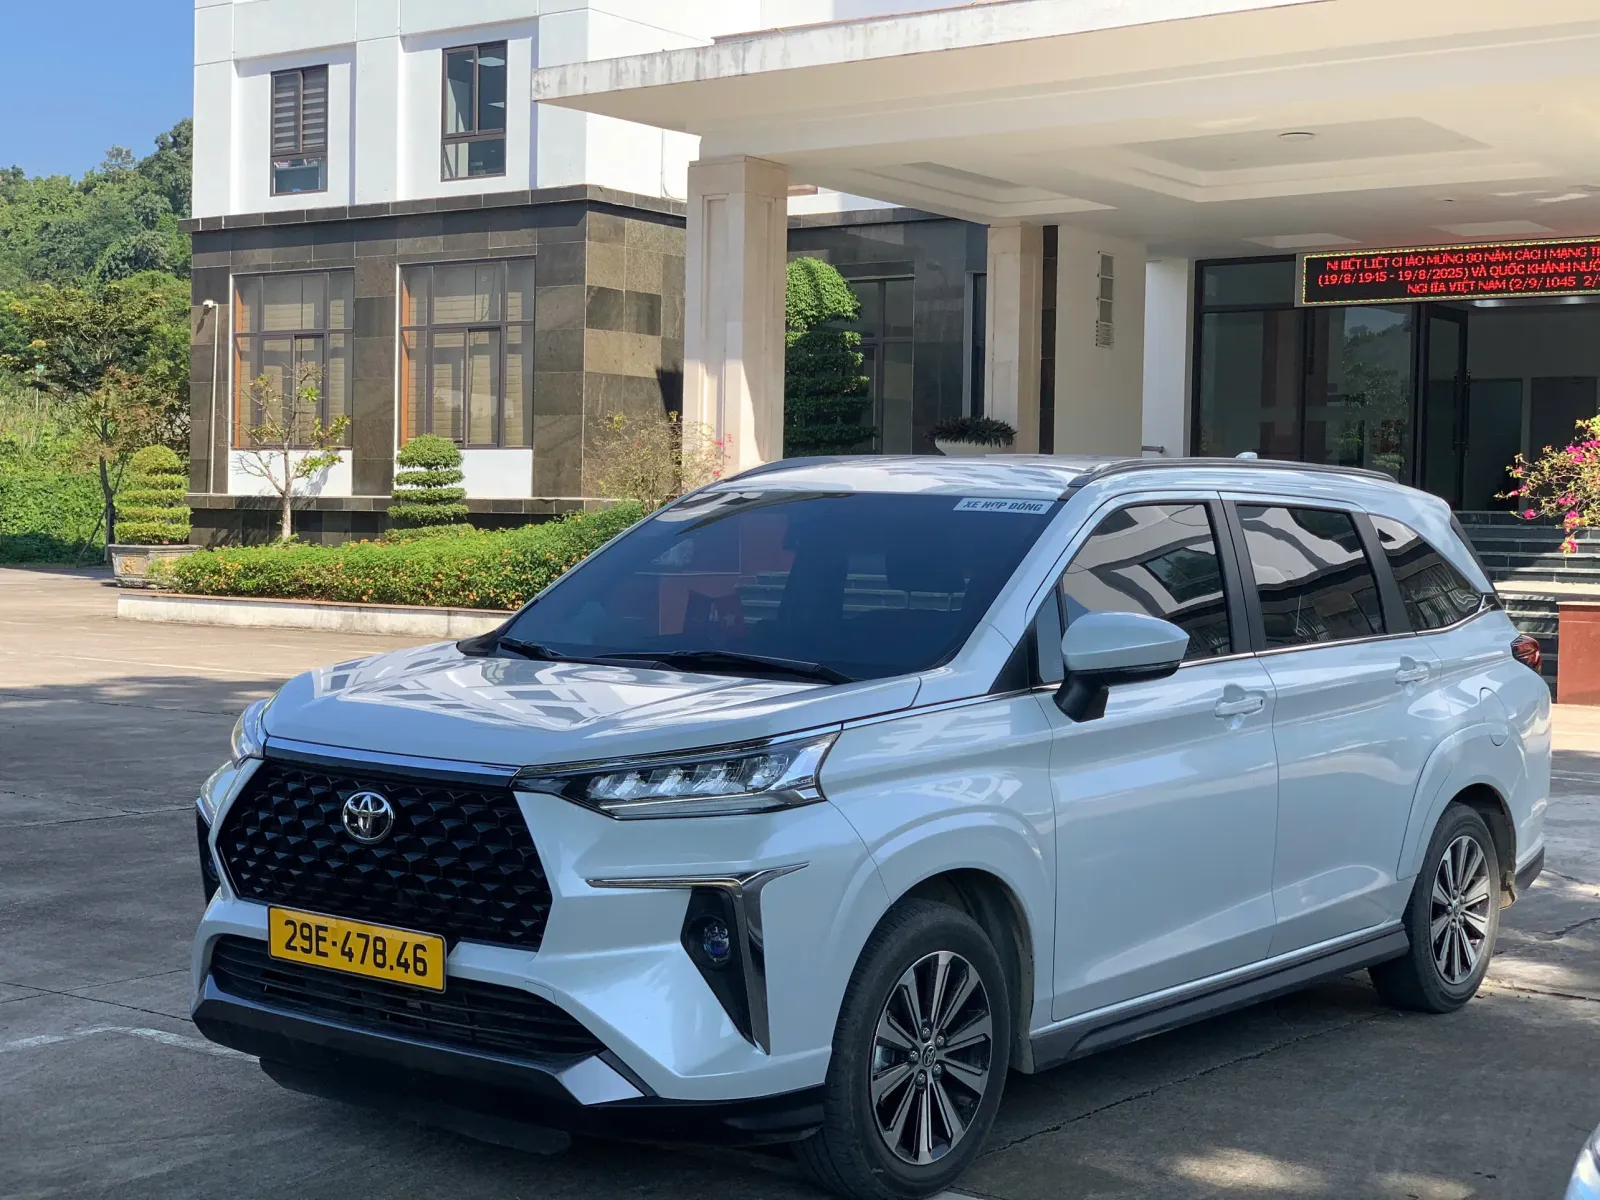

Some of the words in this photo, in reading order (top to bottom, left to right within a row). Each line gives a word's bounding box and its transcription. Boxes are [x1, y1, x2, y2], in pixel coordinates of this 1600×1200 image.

[1484, 248, 1512, 262] NĂM
[1549, 247, 1587, 260] MẠNG
[1398, 267, 1468, 281] 19/8/2025)
[1471, 264, 1487, 277] VÀ
[1489, 262, 1525, 278] QUỐC
[1527, 260, 1571, 274] KHÁNH
[1449, 279, 1476, 294] VIỆT
[1478, 279, 1506, 291] NAM
[963, 500, 982, 508] XE
[981, 501, 1008, 511] HỢP
[284, 919, 428, 977] 29E-478.46
